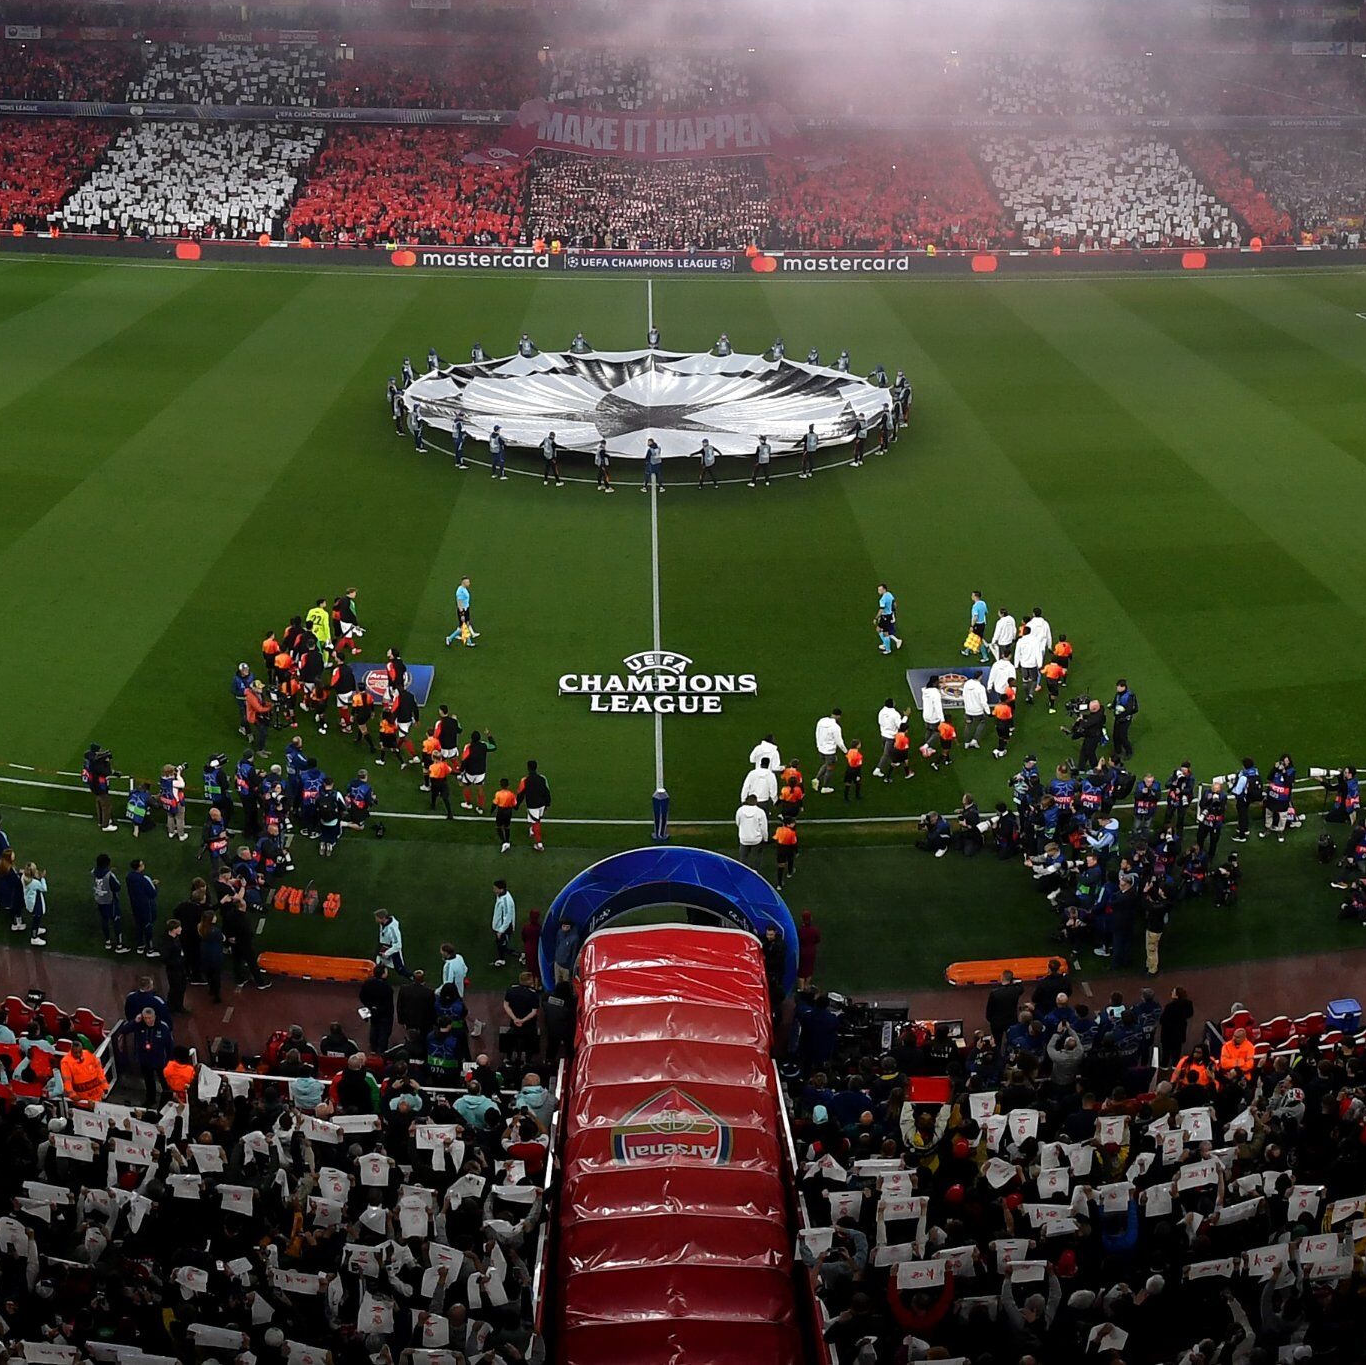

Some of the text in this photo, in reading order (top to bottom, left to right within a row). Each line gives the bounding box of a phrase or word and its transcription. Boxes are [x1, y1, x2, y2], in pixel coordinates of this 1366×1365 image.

[217, 31, 253, 43] Arsenal
[16, 104, 39, 112] LEAGUE
[332, 111, 357, 120] LEAGUE
[536, 111, 771, 154] MAKE IT HAPPEN
[422, 252, 550, 269] mastercard
[580, 258, 718, 269] UEFA CHAMPIONS LEAGUE
[782, 256, 910, 272] mastercard
[311, 615, 322, 625] 22
[625, 654, 686, 674] UEFA
[558, 674, 758, 692] CHAMPIONS
[590, 695, 723, 713] LEAGUE
[628, 1142, 717, 1159] Arsenal
